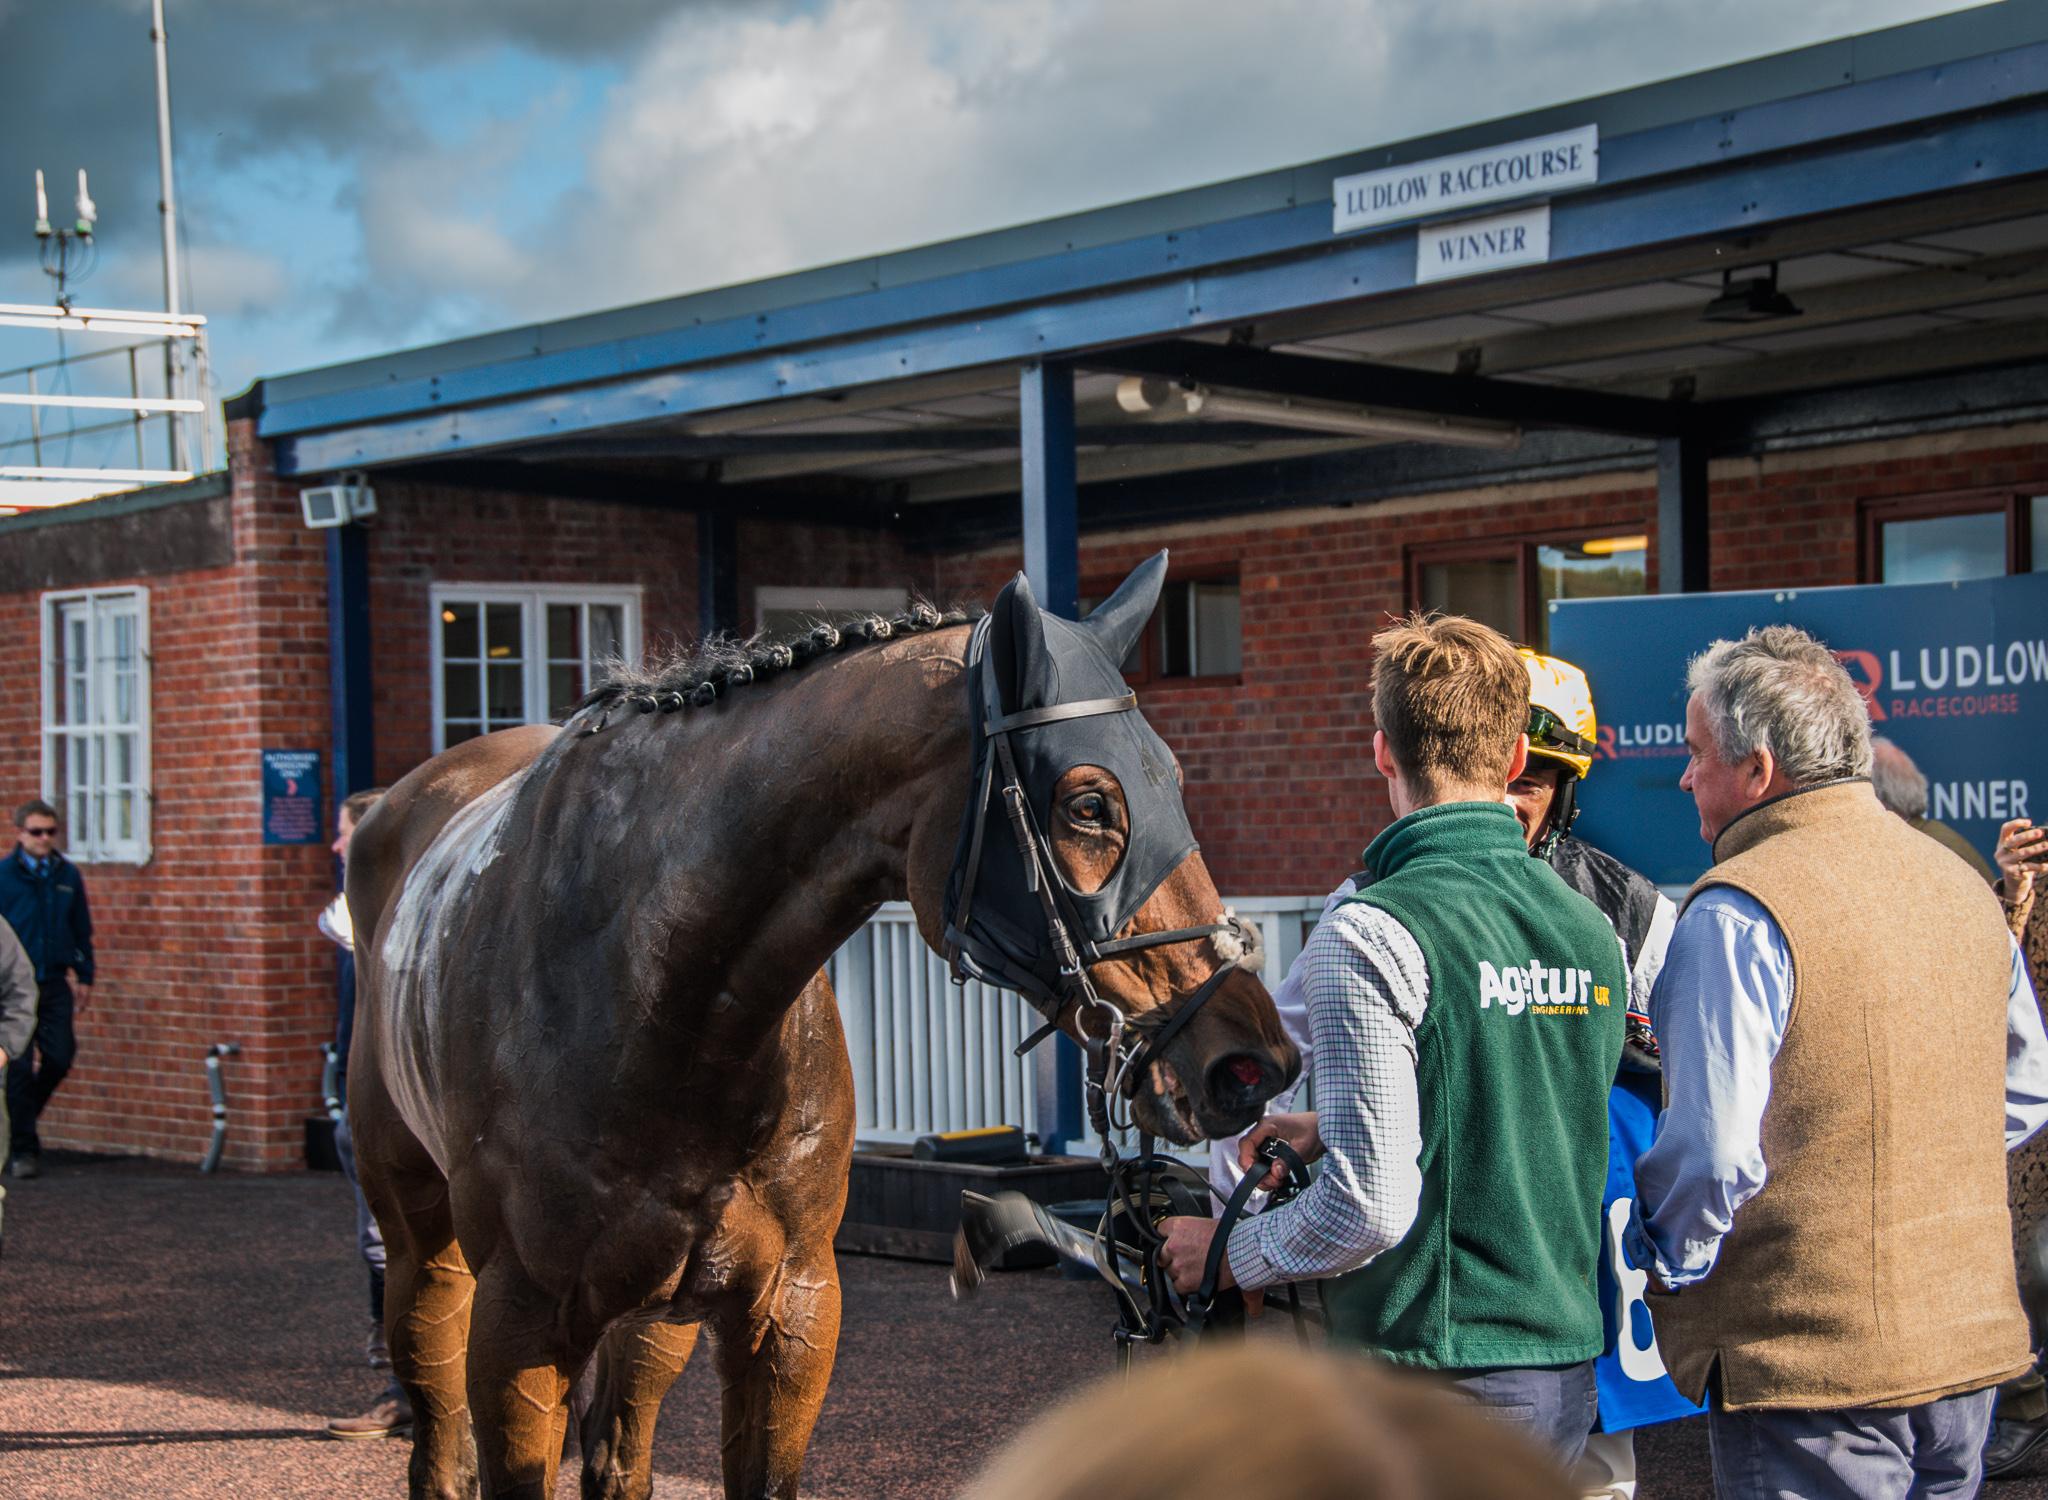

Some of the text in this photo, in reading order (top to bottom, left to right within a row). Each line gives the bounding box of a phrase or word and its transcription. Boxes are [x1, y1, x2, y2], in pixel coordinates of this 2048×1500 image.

[1347, 144, 1583, 215] LUDLOW RACECOURSE
[1439, 226, 1527, 262] WINNER
[1890, 639, 2048, 691] LUDLOW
[1891, 693, 2019, 718] RACECOURSE
[1618, 724, 1686, 746] LUDL
[1922, 780, 2029, 820] NNER
